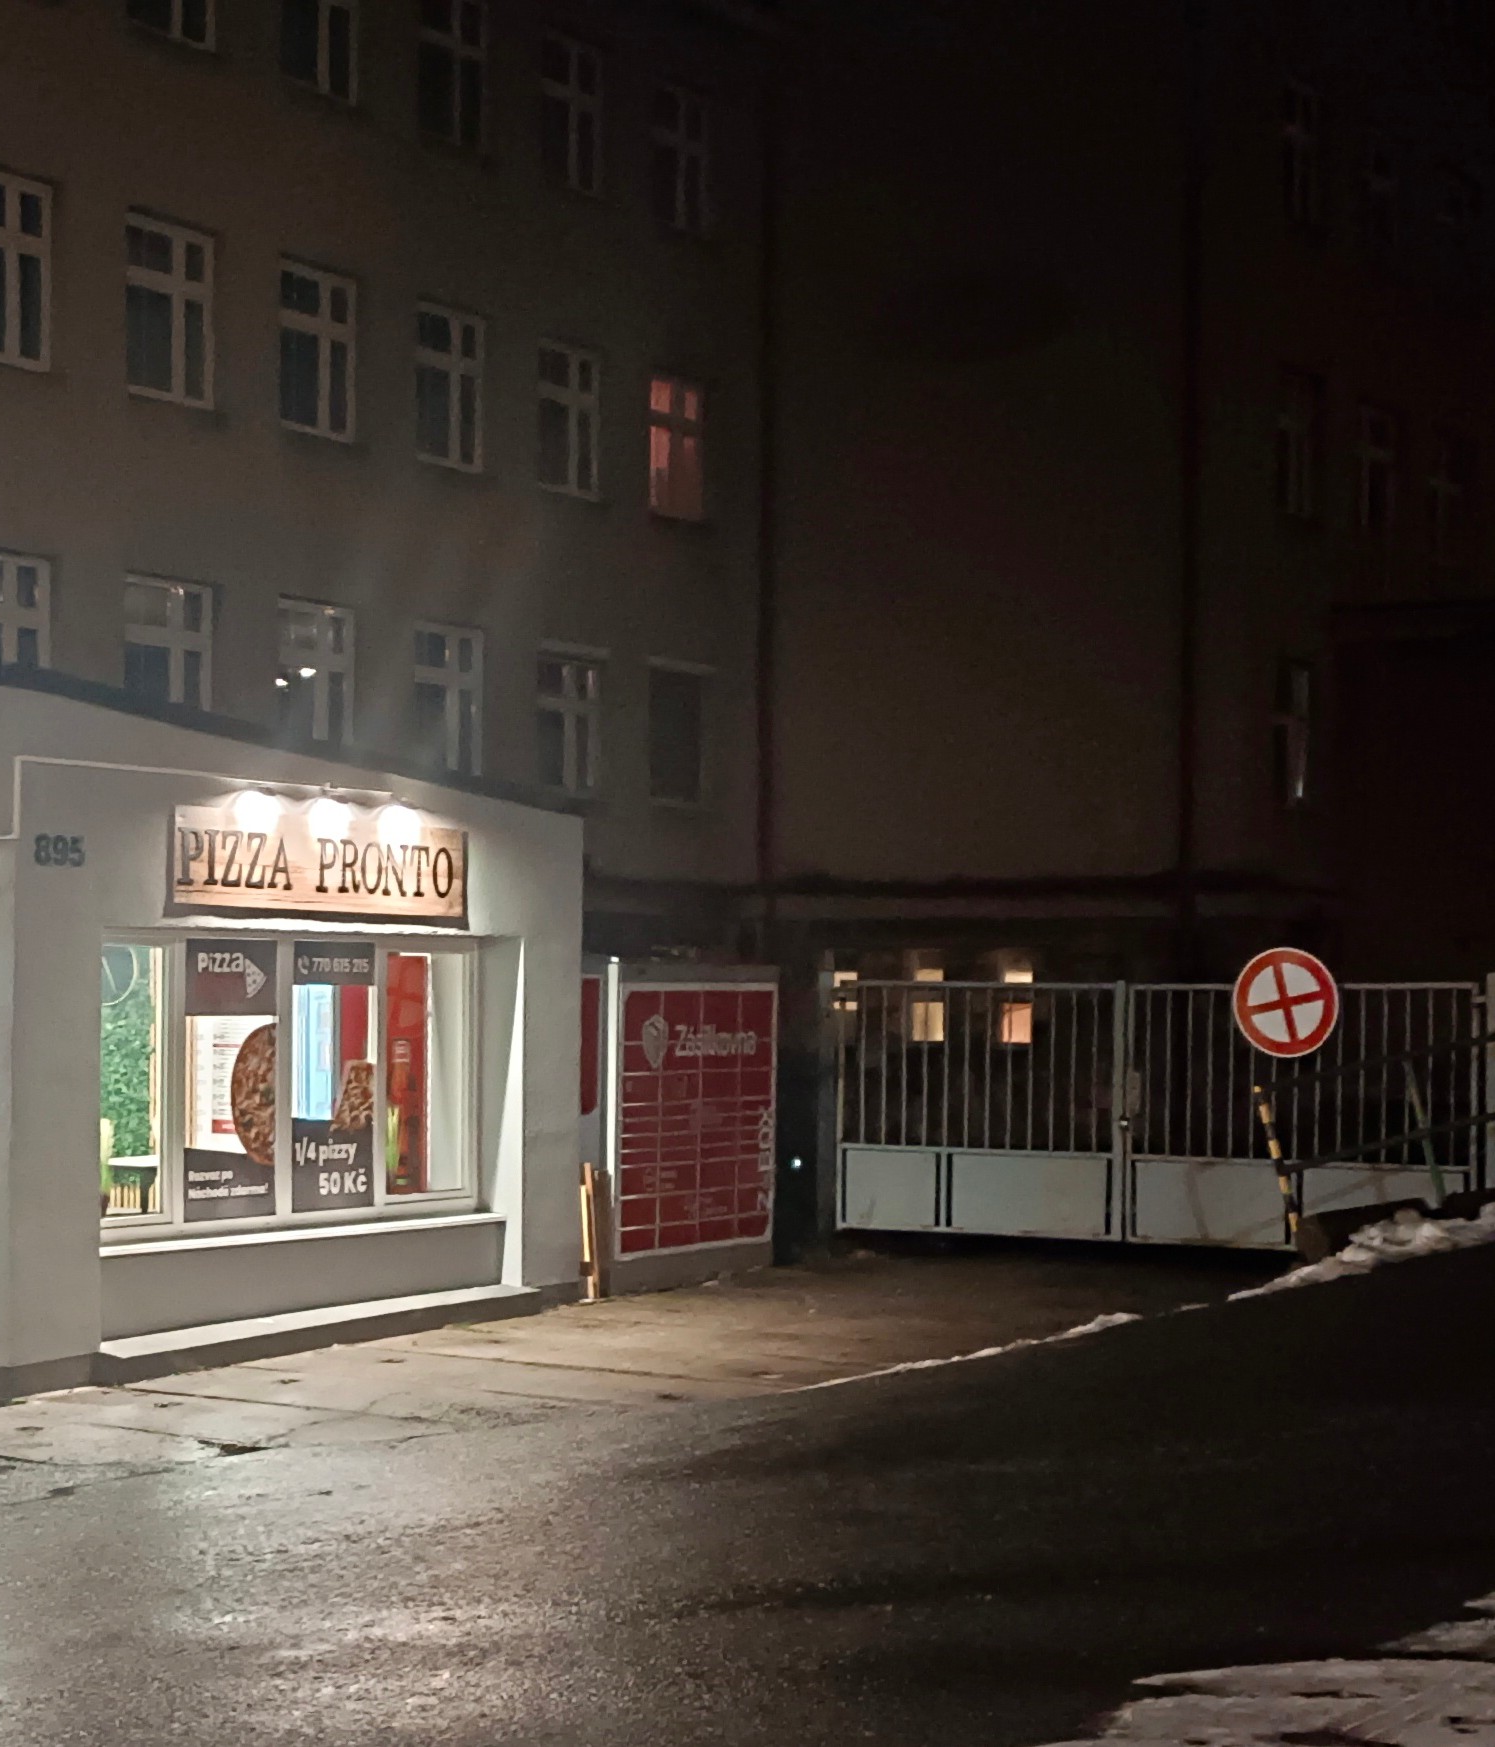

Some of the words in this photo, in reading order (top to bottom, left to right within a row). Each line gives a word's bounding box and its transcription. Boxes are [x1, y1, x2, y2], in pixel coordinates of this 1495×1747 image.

[34, 833, 85, 867] 895
[175, 826, 293, 891] PIZZA
[316, 837, 454, 899] PRONTO
[311, 957, 330, 972] 770
[333, 957, 351, 973] 615
[295, 1136, 317, 1166] 1/4
[318, 1138, 357, 1166] pizzy
[318, 1171, 341, 1195] 50
[343, 1168, 368, 1194] Kč
